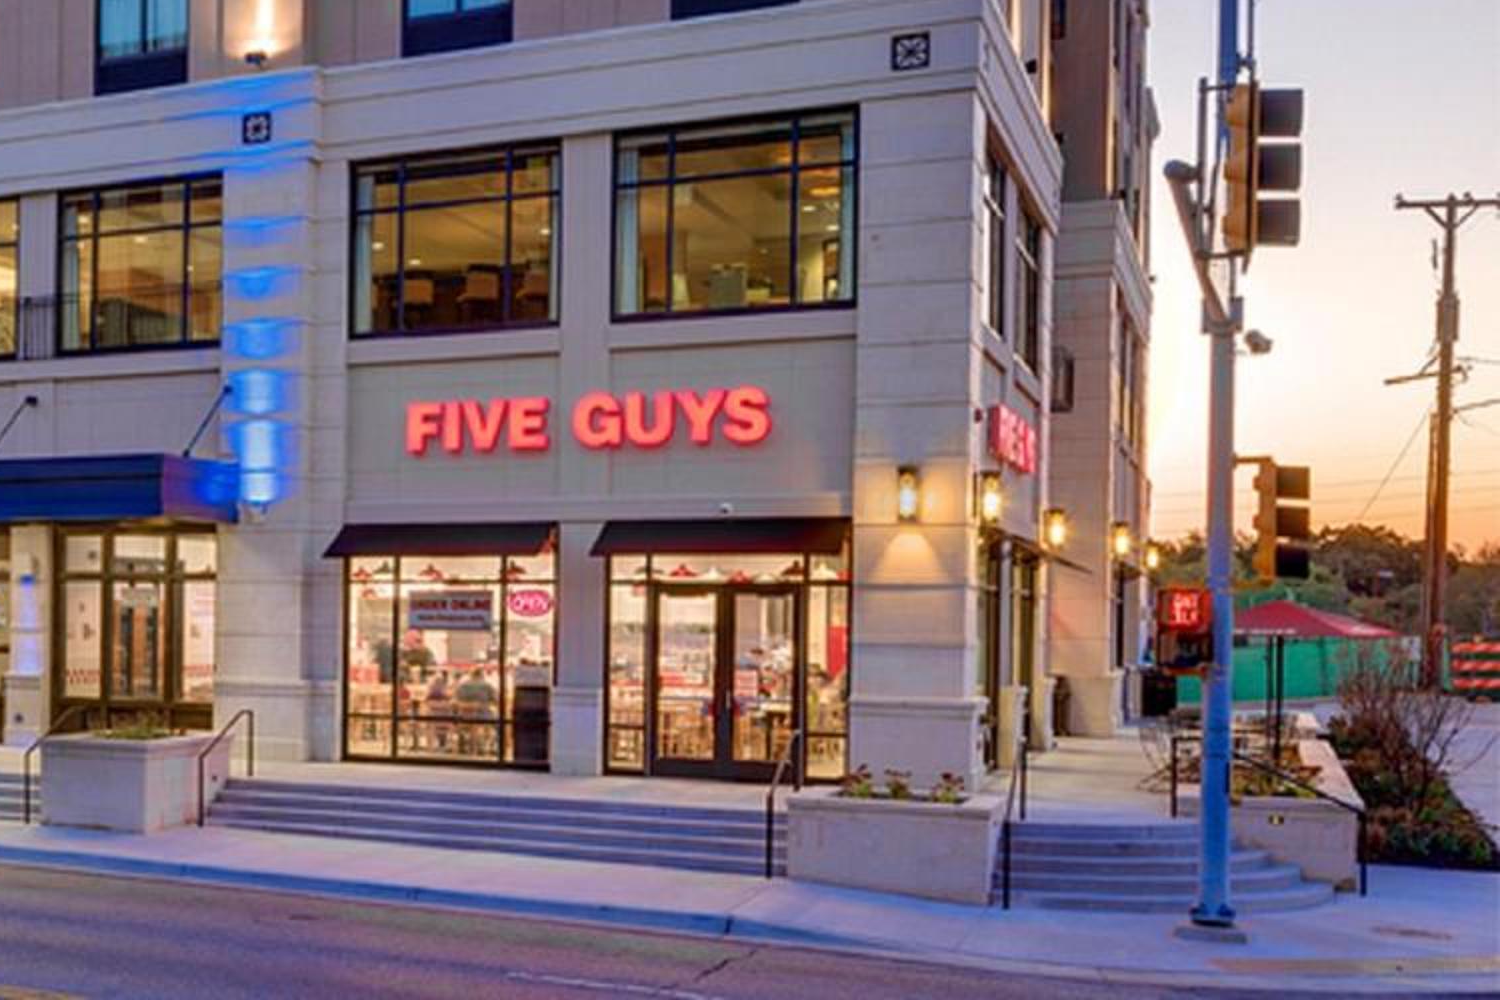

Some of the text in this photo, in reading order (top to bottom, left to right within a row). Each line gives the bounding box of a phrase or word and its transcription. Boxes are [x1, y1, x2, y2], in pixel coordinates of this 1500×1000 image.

[405, 385, 772, 453] FIVE GUYS
[514, 594, 549, 610] OPEN
